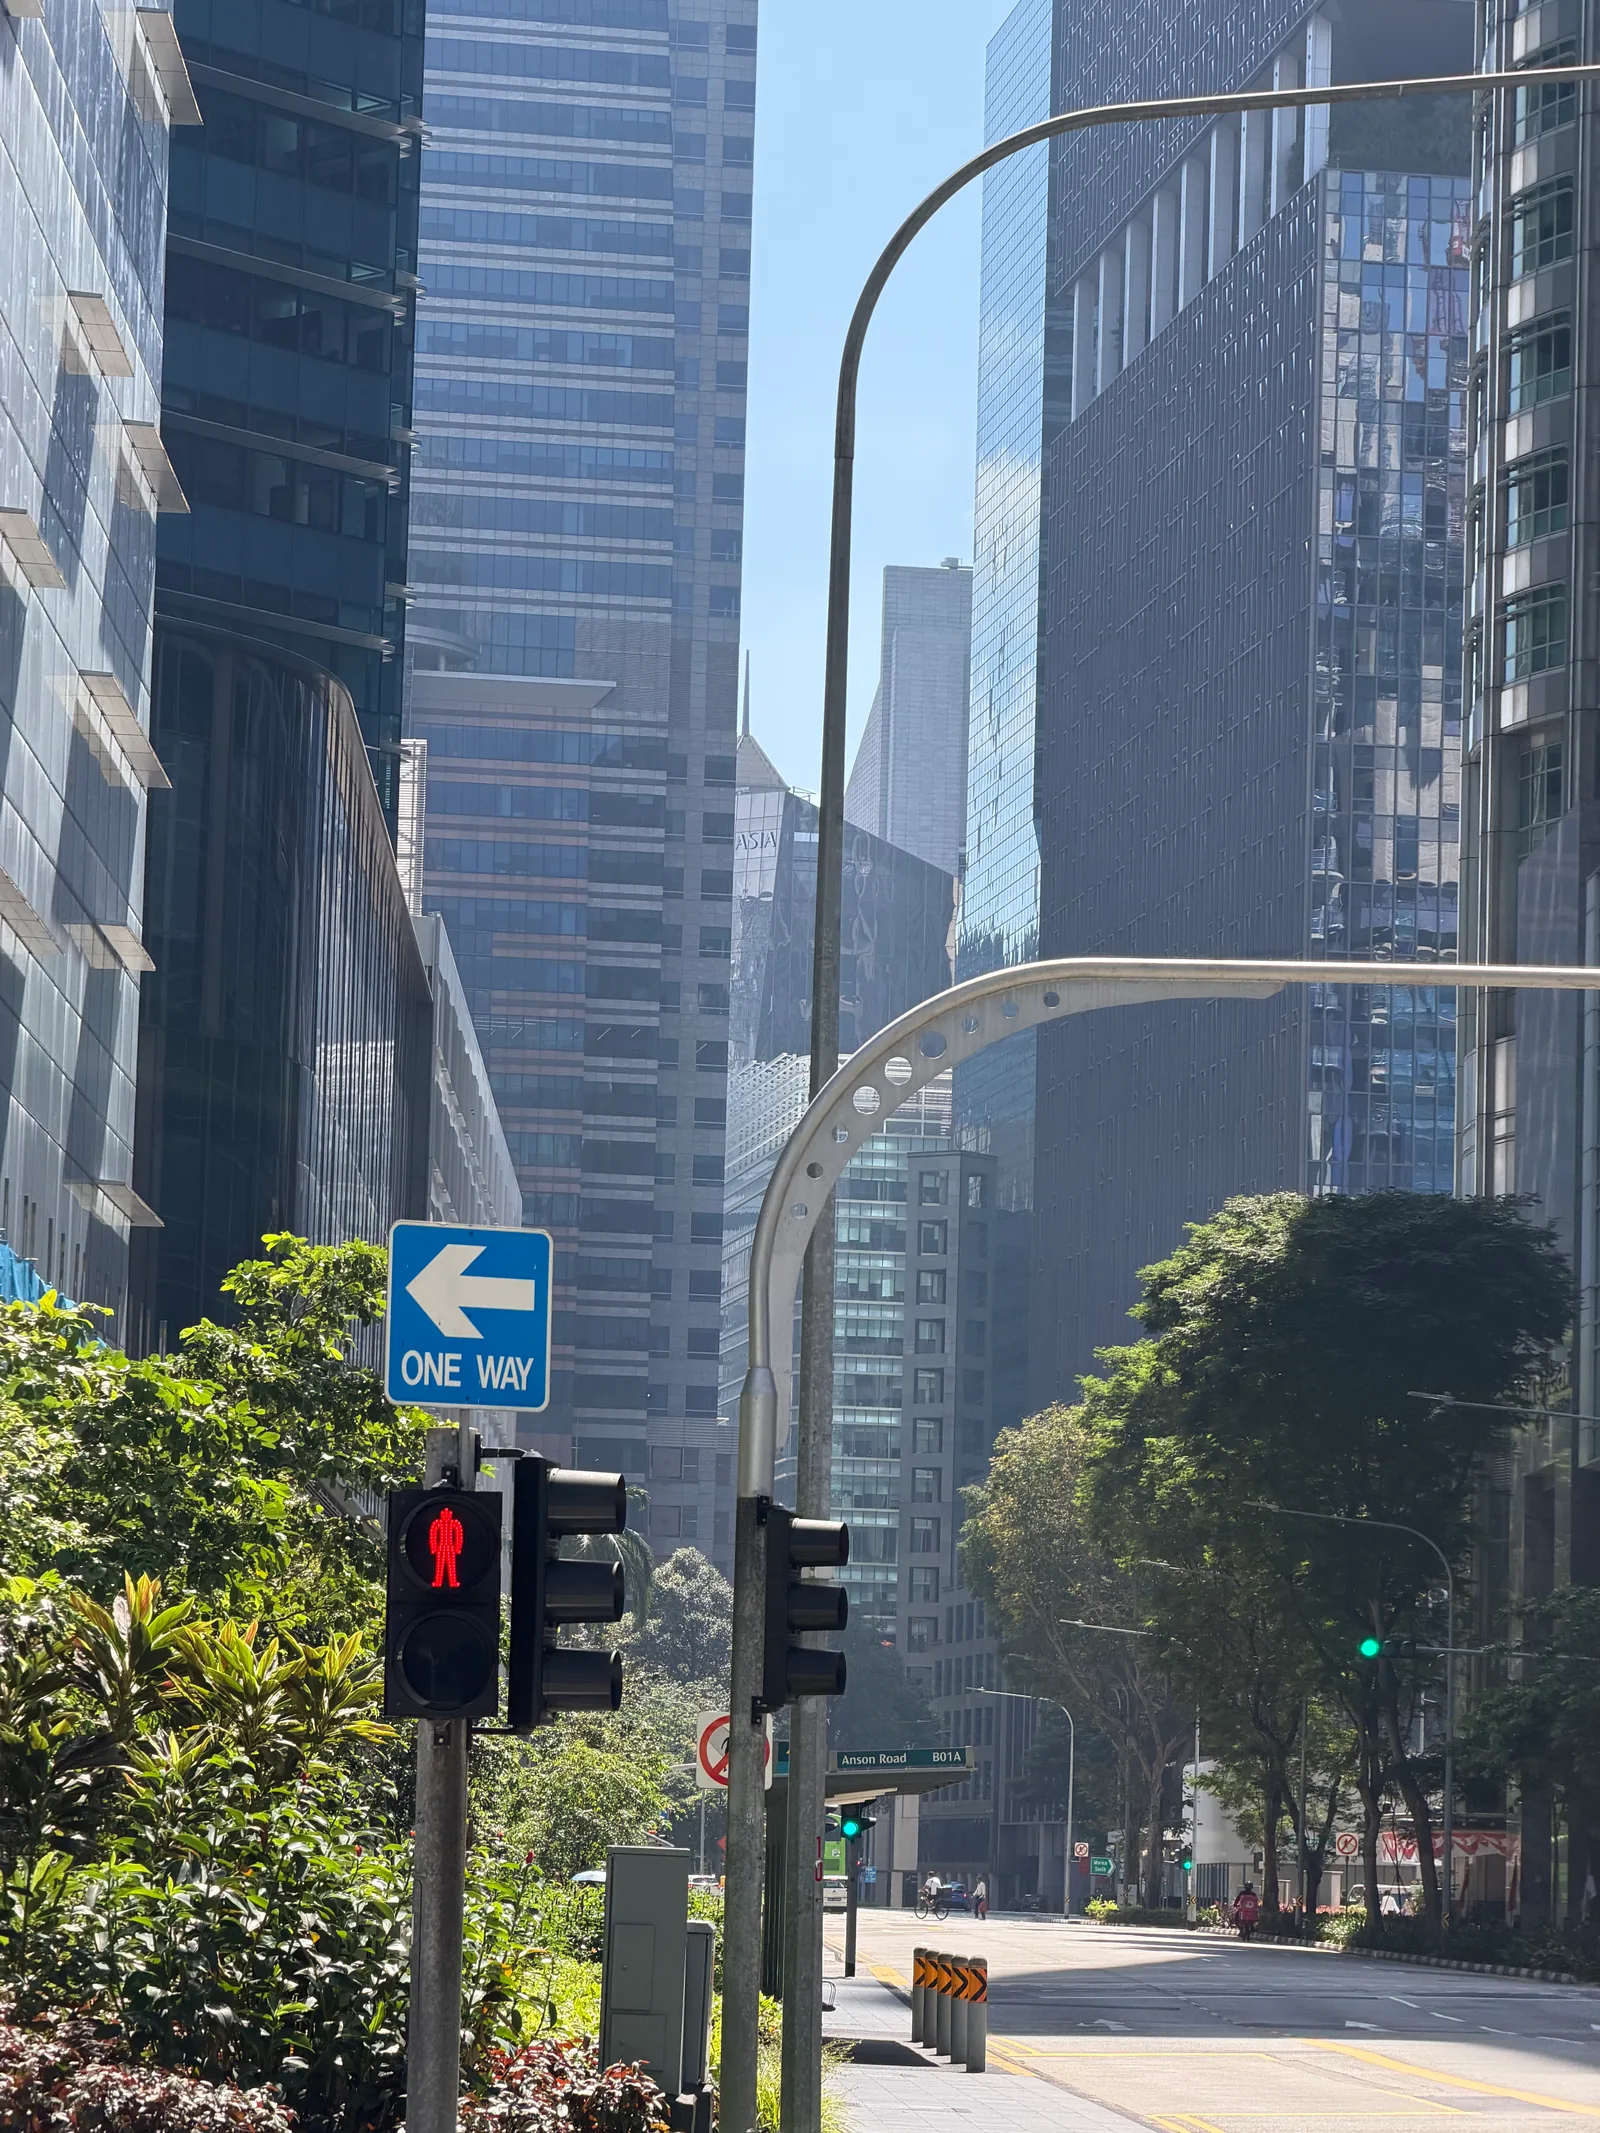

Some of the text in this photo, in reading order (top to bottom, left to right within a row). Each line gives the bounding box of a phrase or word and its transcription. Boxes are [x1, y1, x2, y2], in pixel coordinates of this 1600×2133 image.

[735, 831, 777, 851] ASIA
[401, 1350, 534, 1391] ONE WAY
[841, 1751, 962, 1765] Anson Road B01A
